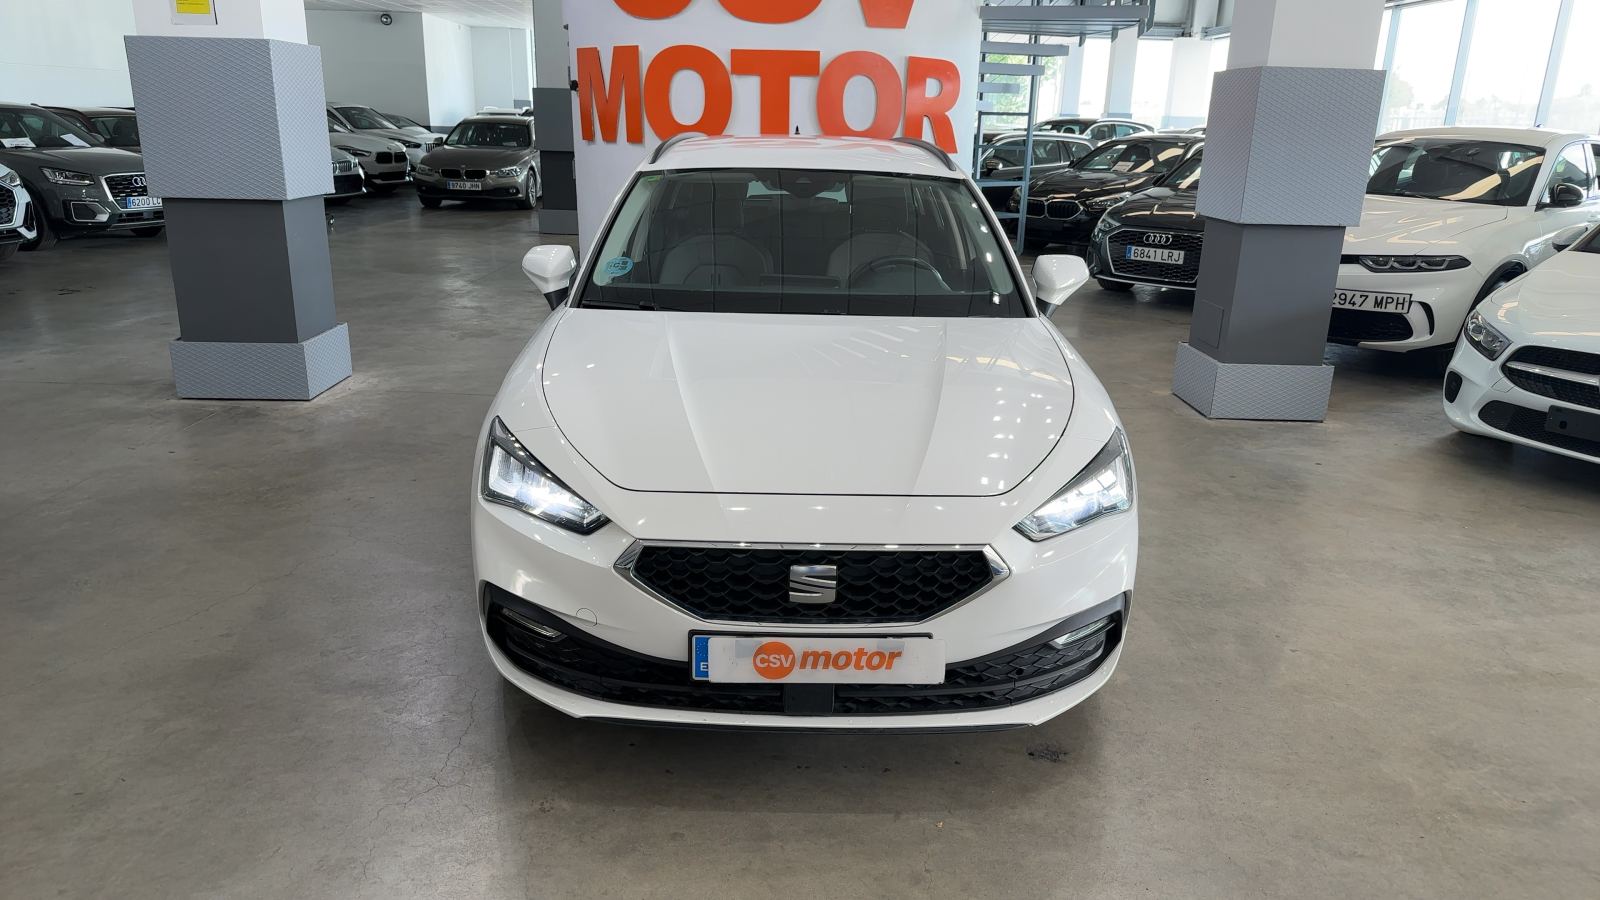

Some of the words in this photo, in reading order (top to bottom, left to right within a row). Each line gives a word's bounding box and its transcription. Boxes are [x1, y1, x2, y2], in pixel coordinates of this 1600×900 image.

[576, 44, 961, 154] MOTOR
[131, 197, 151, 207] 6200
[1133, 247, 1157, 260] 6841
[1160, 250, 1181, 262] LRJ
[1373, 295, 1406, 310] MPH
[755, 654, 794, 668] CSV
[800, 647, 903, 671] motor
